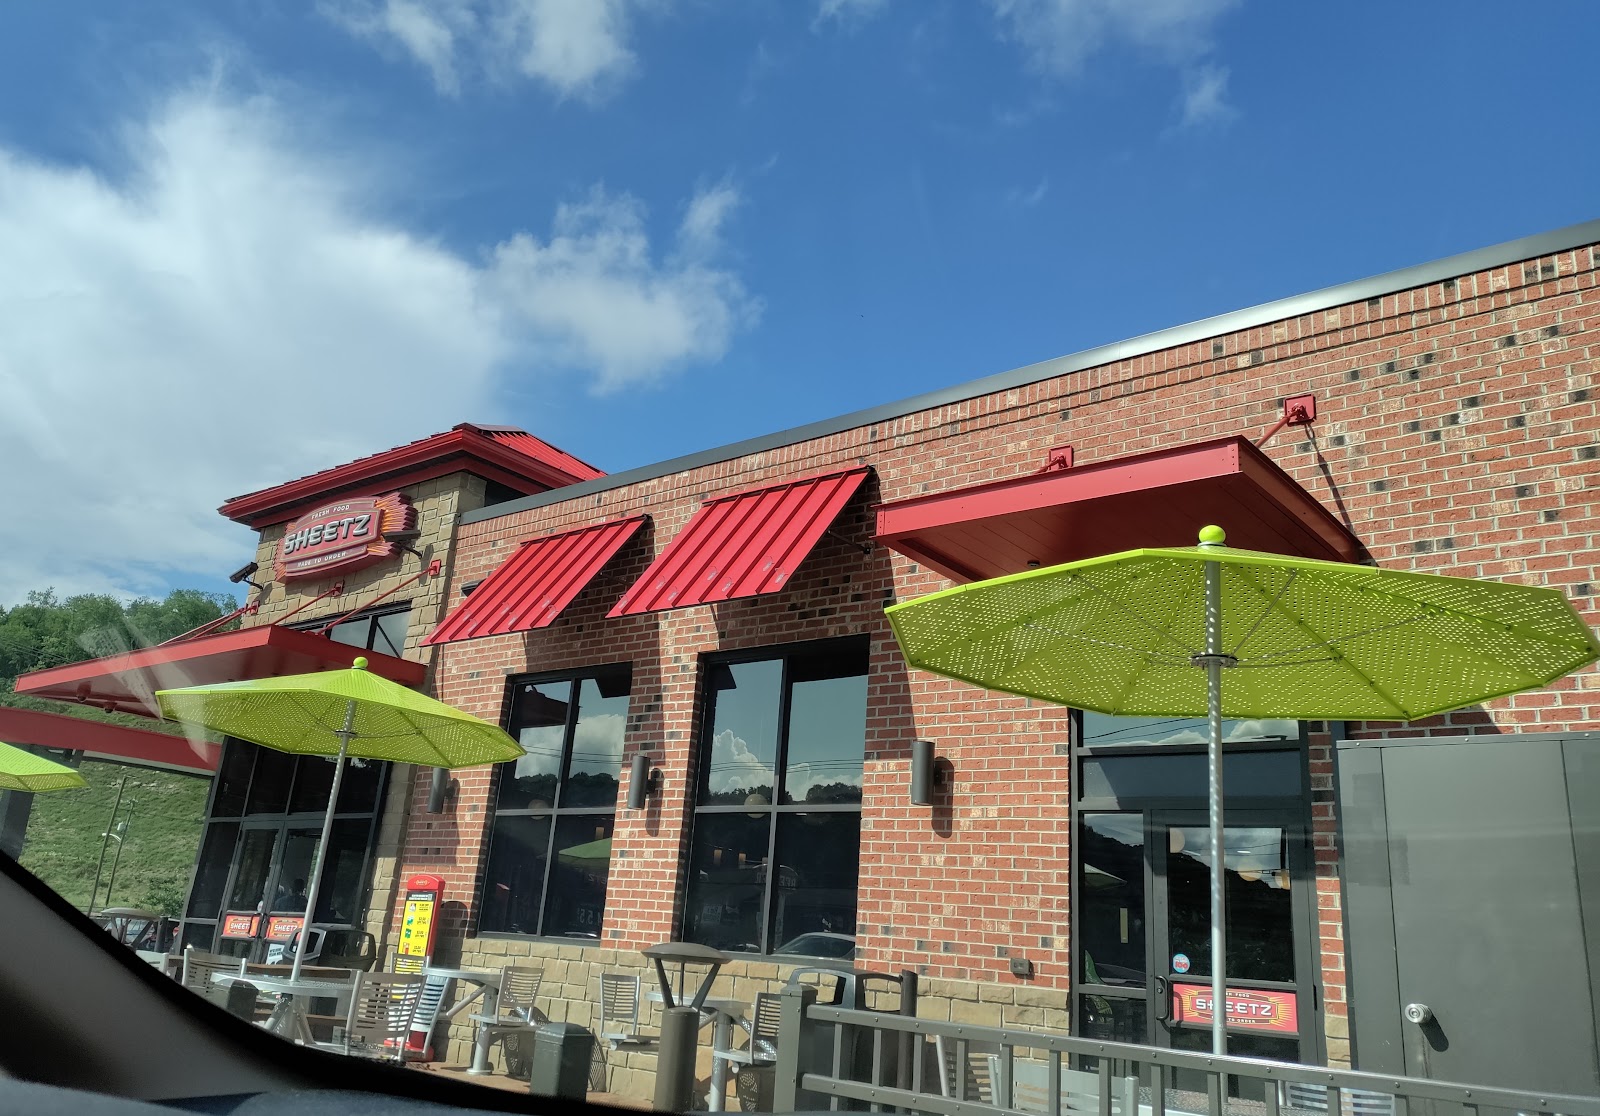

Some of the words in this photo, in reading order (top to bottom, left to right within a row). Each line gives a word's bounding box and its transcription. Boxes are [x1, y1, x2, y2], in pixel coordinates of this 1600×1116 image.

[311, 509, 330, 520] FRESH
[332, 504, 350, 513] FOOD
[284, 514, 372, 555] SHEETZ
[297, 559, 312, 568] MADE
[314, 557, 322, 565] TO
[324, 551, 347, 562] ORDER
